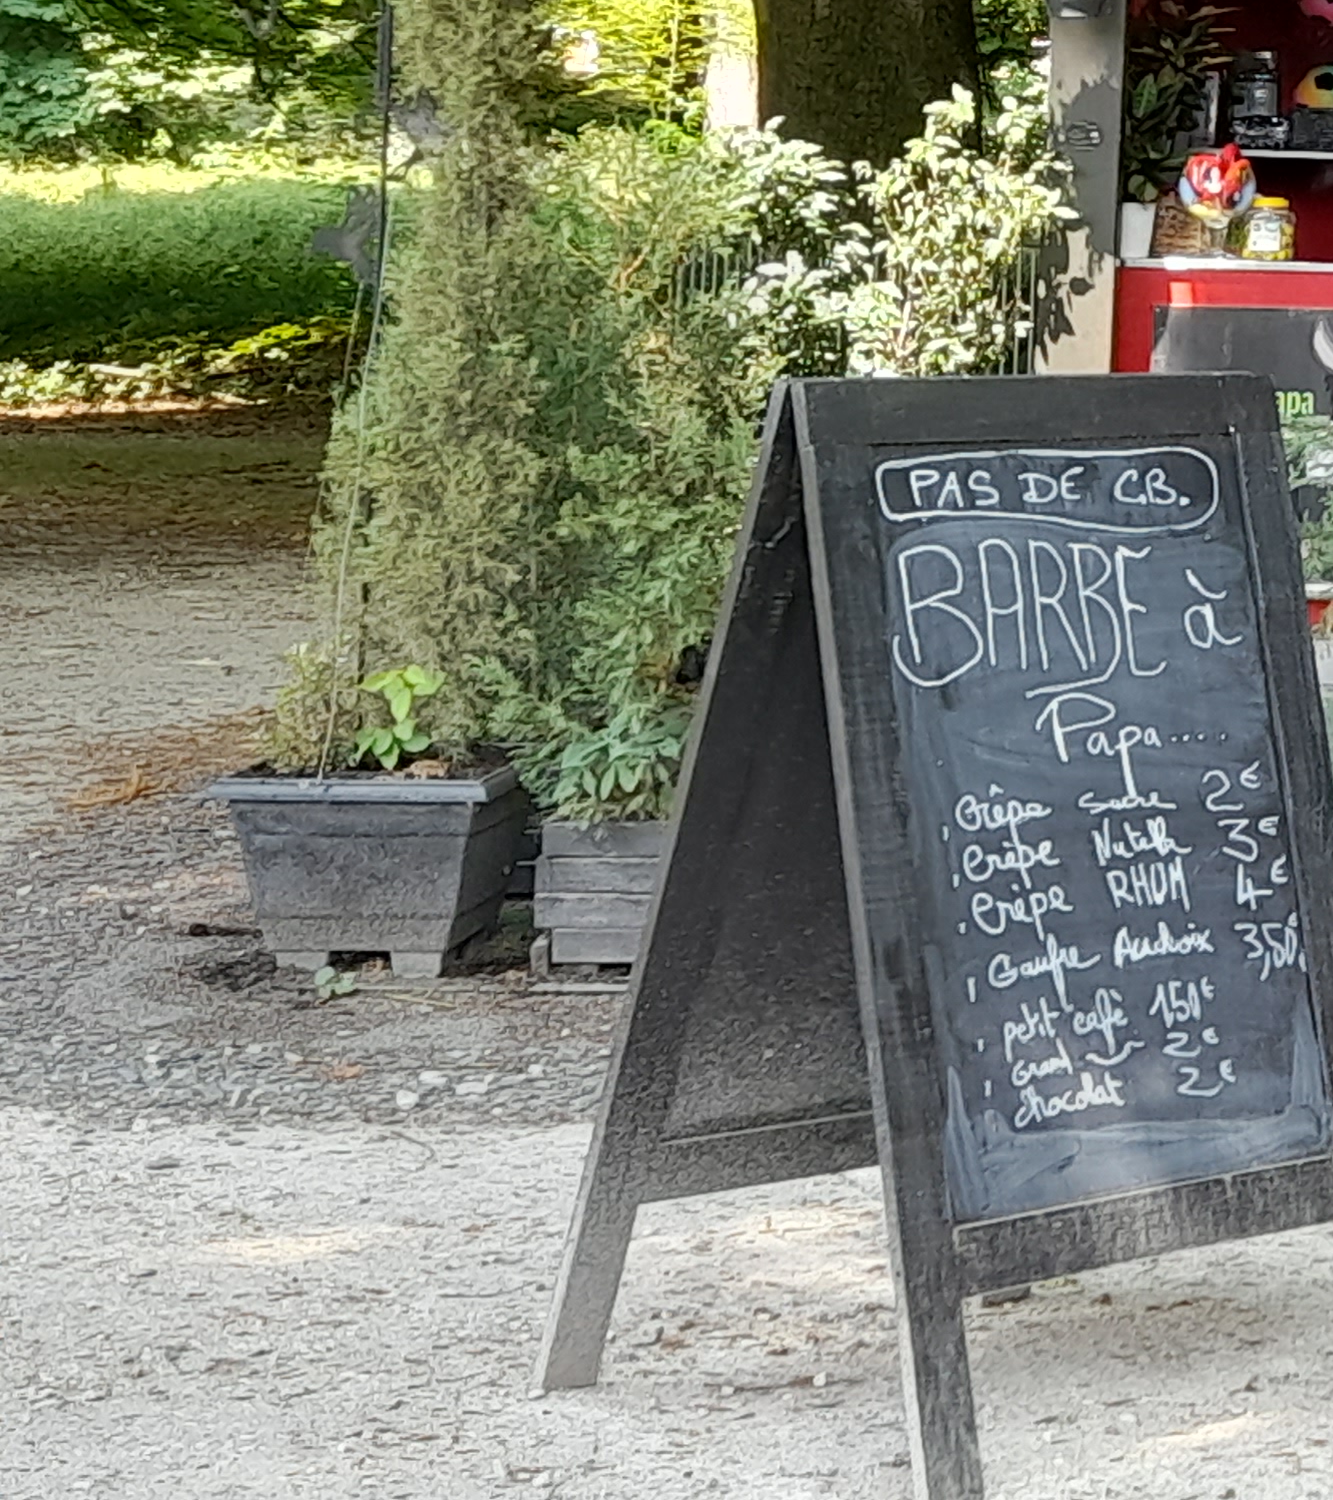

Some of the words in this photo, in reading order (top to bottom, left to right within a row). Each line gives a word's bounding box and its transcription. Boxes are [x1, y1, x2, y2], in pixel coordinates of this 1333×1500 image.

[909, 468, 1000, 509] PAS
[1017, 466, 1085, 504] DE
[892, 538, 1168, 699] BARBE
[1183, 568, 1243, 649] à
[955, 783, 1053, 846] Crêpe
[1105, 856, 1191, 912] RHUM
[987, 932, 1102, 1011] Gaufre
[1002, 997, 1062, 1062] petit
